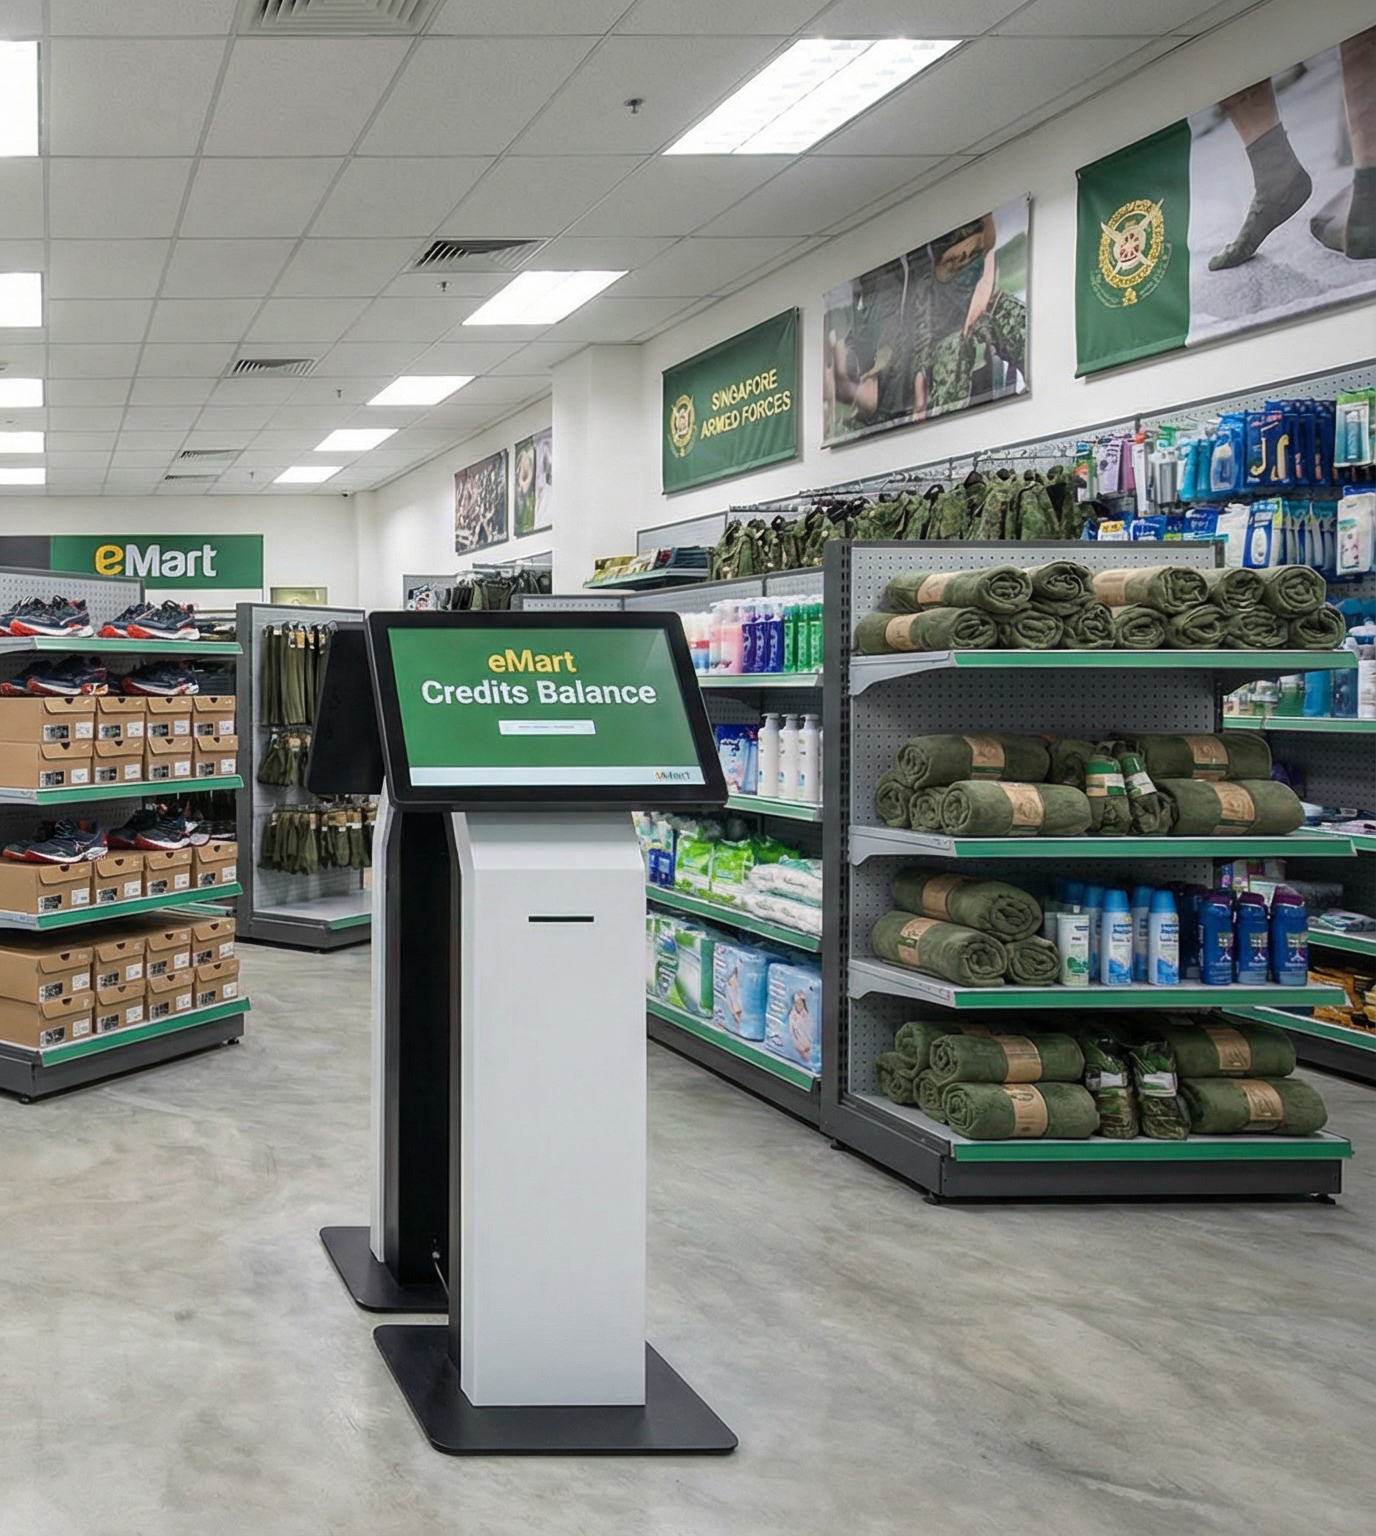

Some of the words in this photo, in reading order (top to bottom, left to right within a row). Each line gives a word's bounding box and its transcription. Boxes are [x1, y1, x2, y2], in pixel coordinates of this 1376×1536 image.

[700, 411, 740, 440] ARMED
[741, 390, 791, 426] FORCES
[95, 544, 217, 577] eMart
[488, 649, 577, 673] eMart
[421, 679, 529, 705] Credits
[535, 679, 656, 705] Balance
